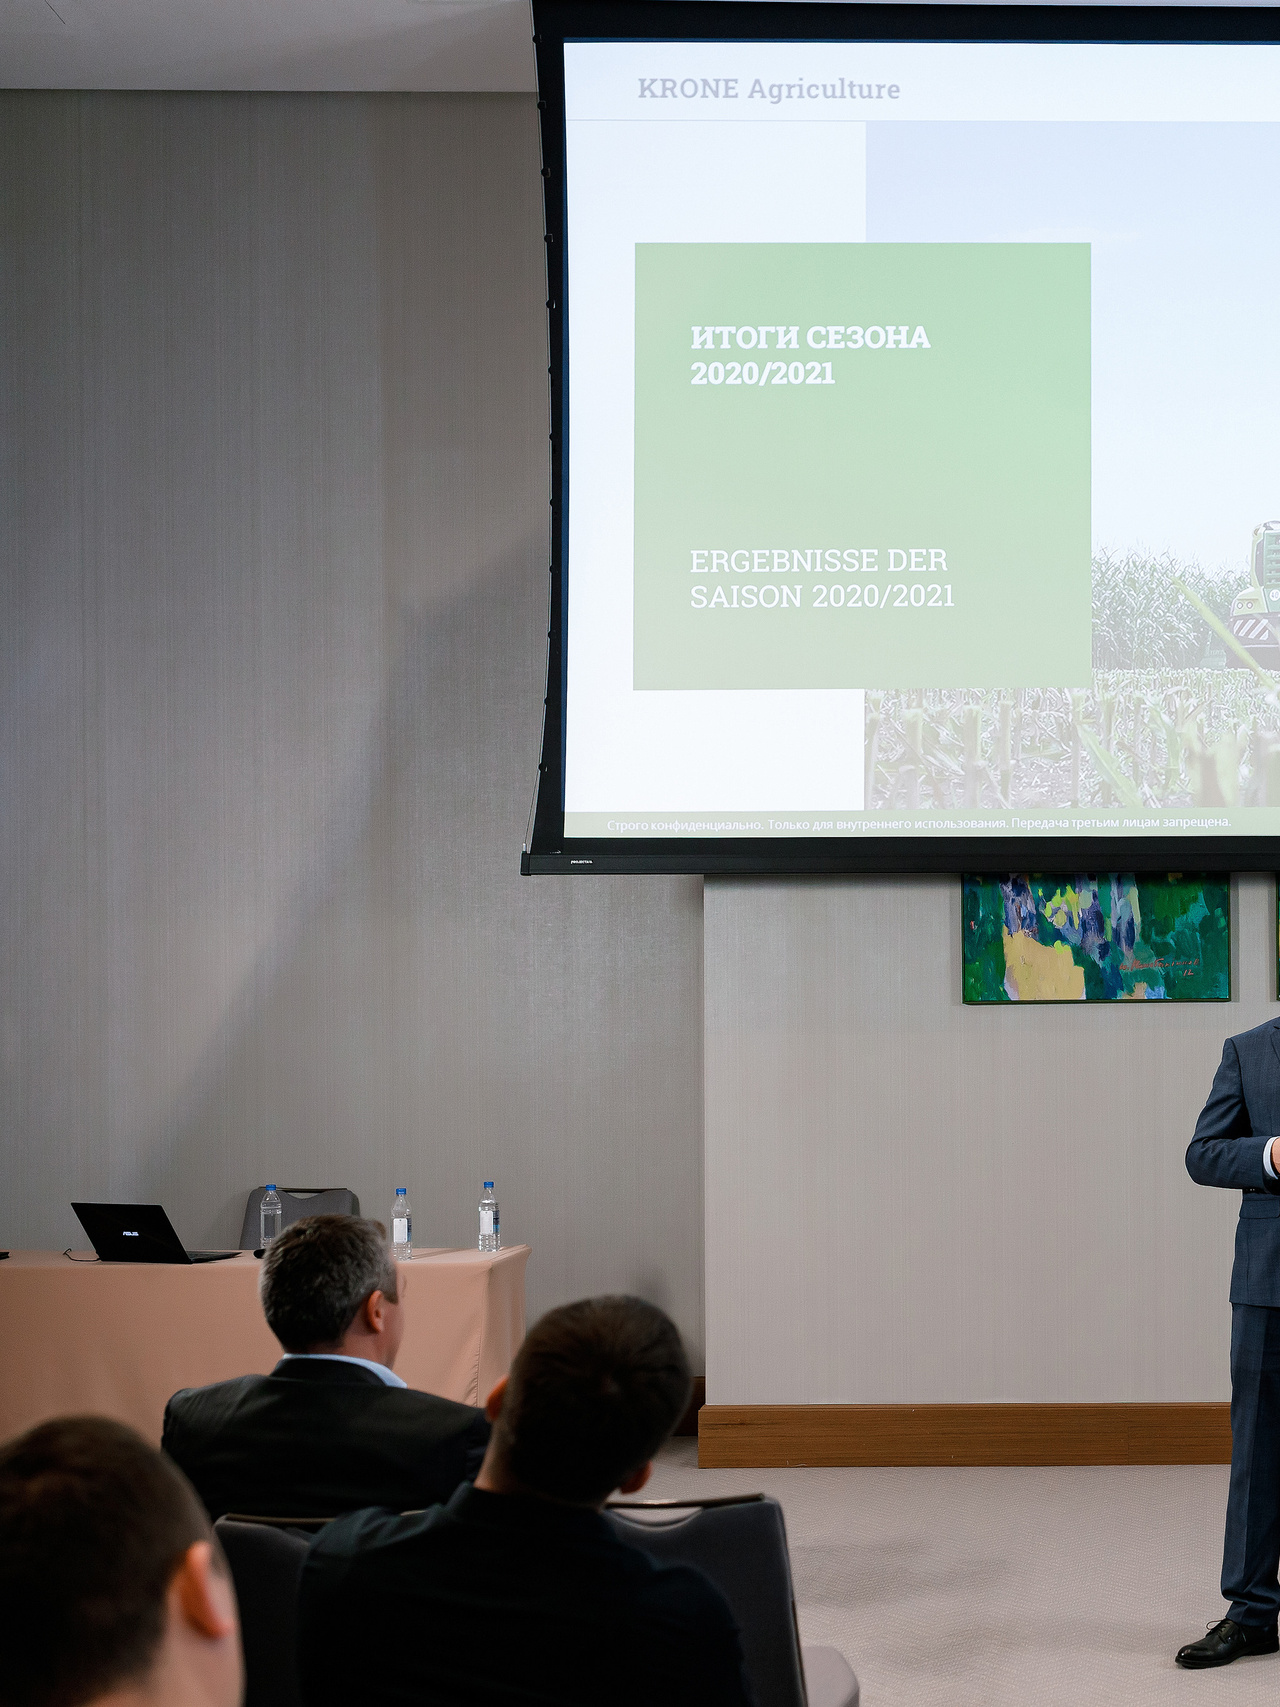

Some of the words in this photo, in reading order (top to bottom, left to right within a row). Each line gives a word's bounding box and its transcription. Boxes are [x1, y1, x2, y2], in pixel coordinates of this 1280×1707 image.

[637, 78, 739, 99] KRONE
[747, 77, 901, 105] Agriculture
[690, 325, 800, 350] ИТОГИ
[806, 325, 932, 349] СЕЗОНА
[690, 361, 836, 387] 2020/2021
[690, 548, 879, 573] ERGEBNISSE
[887, 548, 948, 572] DER
[690, 584, 803, 609] SAISON
[812, 583, 955, 609] 2020/2021
[607, 820, 649, 833] Строго
[650, 819, 765, 832] конфиденциально.
[767, 819, 810, 830] Только
[812, 820, 834, 833] для
[836, 820, 912, 832] внутреннего
[914, 819, 1009, 829] использования.
[1011, 817, 1069, 831] Передача
[1071, 819, 1120, 831] третьим
[1122, 818, 1160, 829] лицам
[1162, 818, 1232, 830] запрещена.
